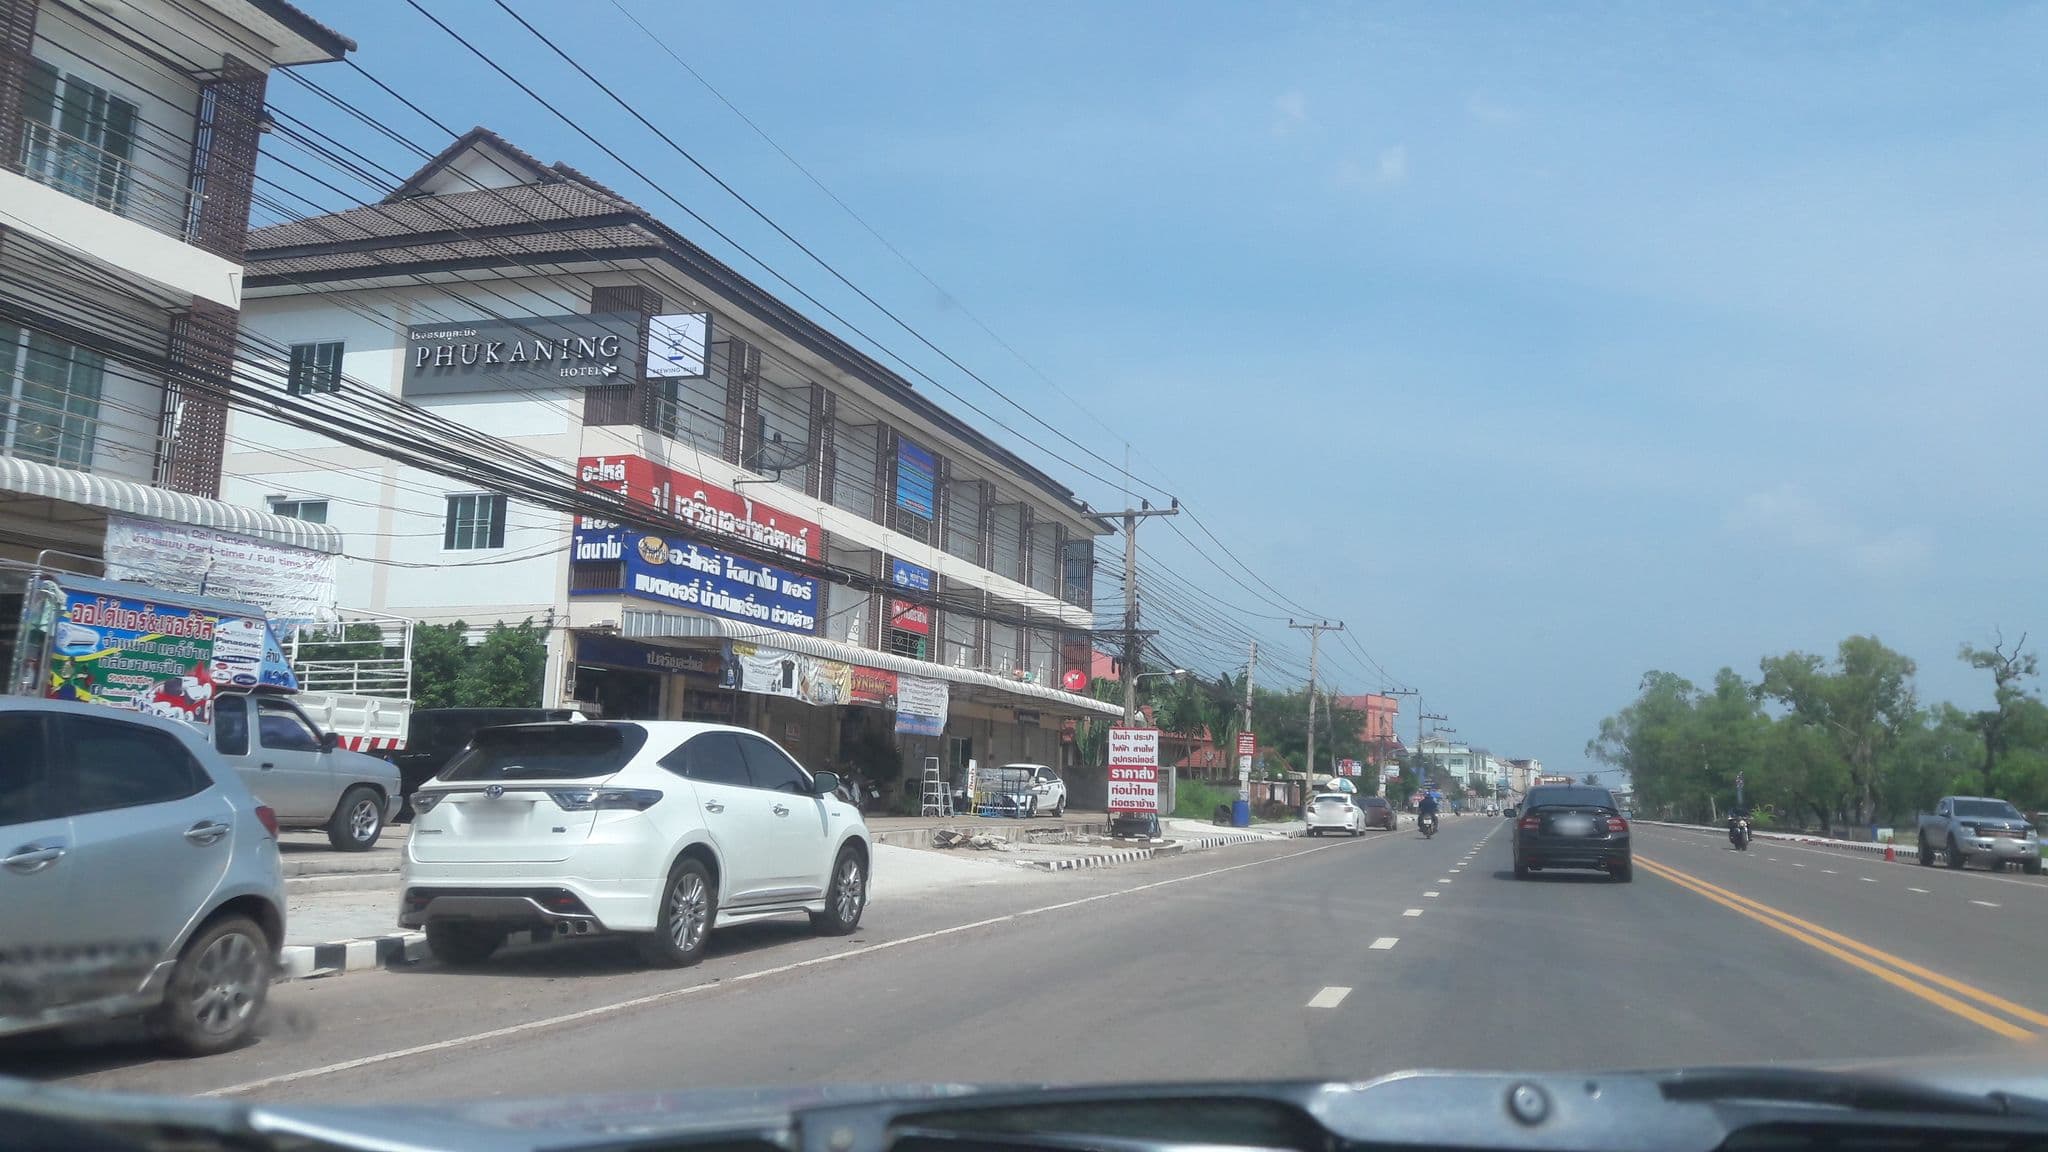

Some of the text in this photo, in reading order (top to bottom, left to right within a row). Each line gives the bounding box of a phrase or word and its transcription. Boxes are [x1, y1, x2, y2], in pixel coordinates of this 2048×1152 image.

[415, 335, 619, 367] PHUKANING
[560, 367, 601, 377] HOTEL
[582, 457, 626, 482] อะไหล่
[187, 542, 245, 560] Part-time
[257, 554, 275, 564] Full
[575, 534, 621, 560] ไดนาโม
[635, 573, 699, 604] แบตเตอรี่
[215, 636, 262, 649] Panasonic
[1111, 766, 1155, 780] ราคาส่ง
[1111, 782, 1155, 796] ท่อน้ำไทย
